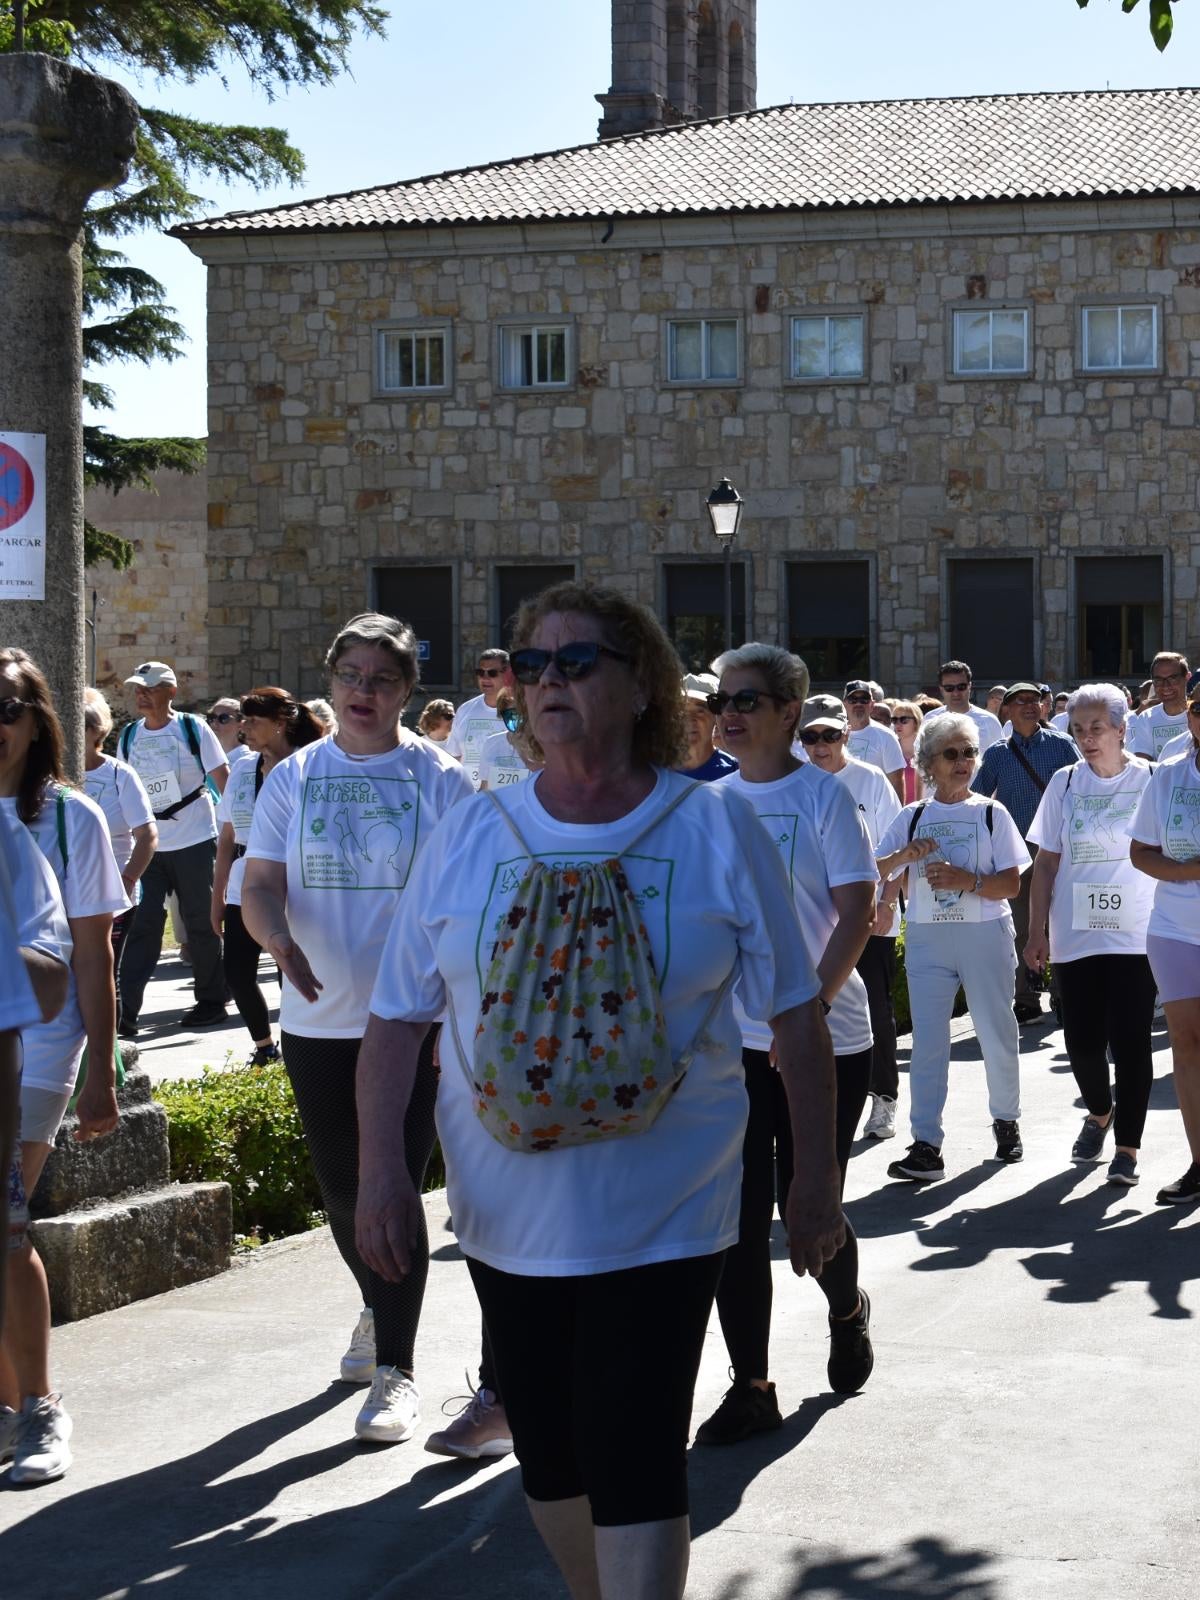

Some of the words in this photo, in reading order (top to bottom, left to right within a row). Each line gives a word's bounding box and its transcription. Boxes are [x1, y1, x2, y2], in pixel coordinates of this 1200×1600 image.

[497, 773, 519, 784] 270
[147, 779, 168, 795] 307
[310, 783, 322, 793] IX
[327, 782, 371, 794] PASEO
[310, 793, 379, 804] SALUDABLE
[502, 866, 519, 883] IX
[1088, 893, 1122, 910] 159
